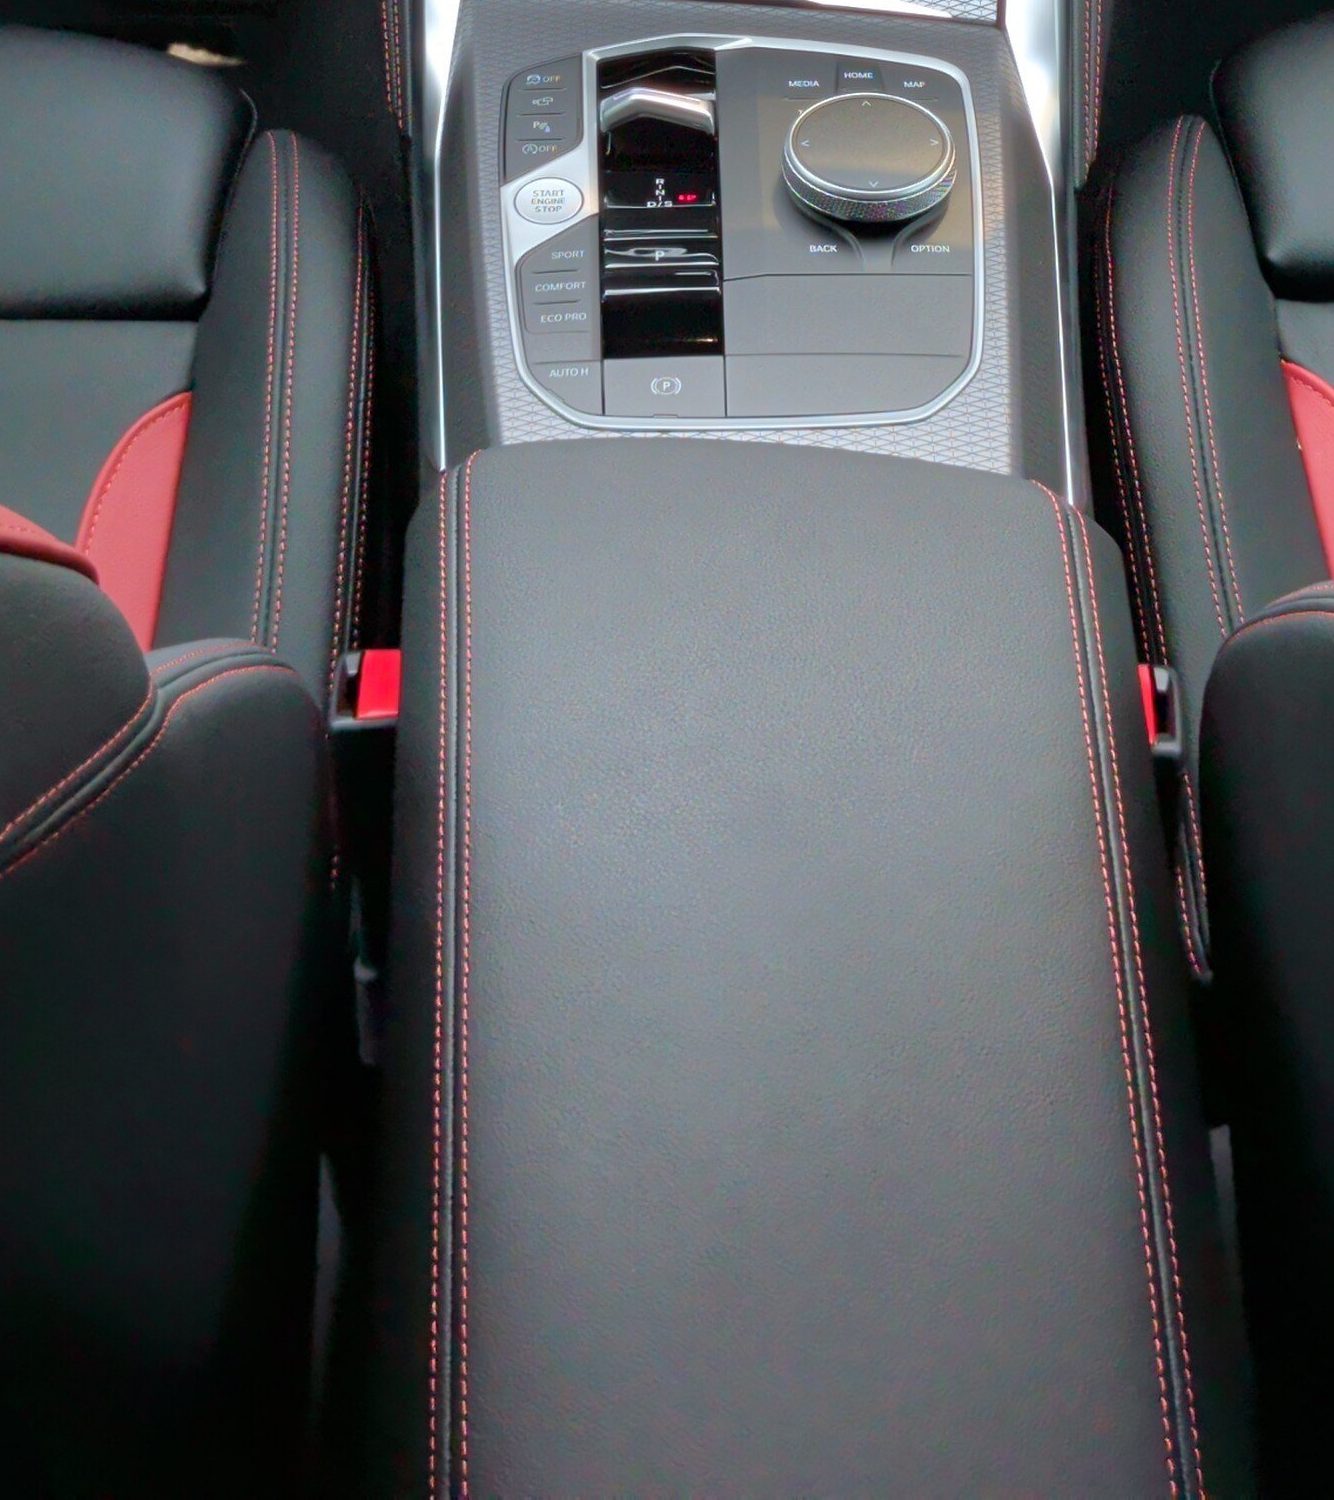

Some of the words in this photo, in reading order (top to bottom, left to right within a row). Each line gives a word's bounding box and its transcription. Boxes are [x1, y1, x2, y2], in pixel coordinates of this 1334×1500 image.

[542, 74, 562, 84] OFF
[844, 71, 874, 80] HOME
[788, 80, 820, 88] MEDIA
[903, 81, 926, 89] MAP
[538, 144, 558, 154] OFF
[532, 189, 566, 197] START
[531, 197, 566, 205] ENGINE
[534, 205, 563, 213] STOP
[809, 244, 838, 253] BACK
[910, 244, 951, 253] OPTION
[551, 250, 585, 260] SPORT
[655, 250, 665, 261] P
[535, 281, 586, 292] COMFORT
[540, 313, 563, 323] ECO
[565, 312, 587, 322] PRO
[549, 367, 579, 378] AUTO
[580, 367, 589, 377] H
